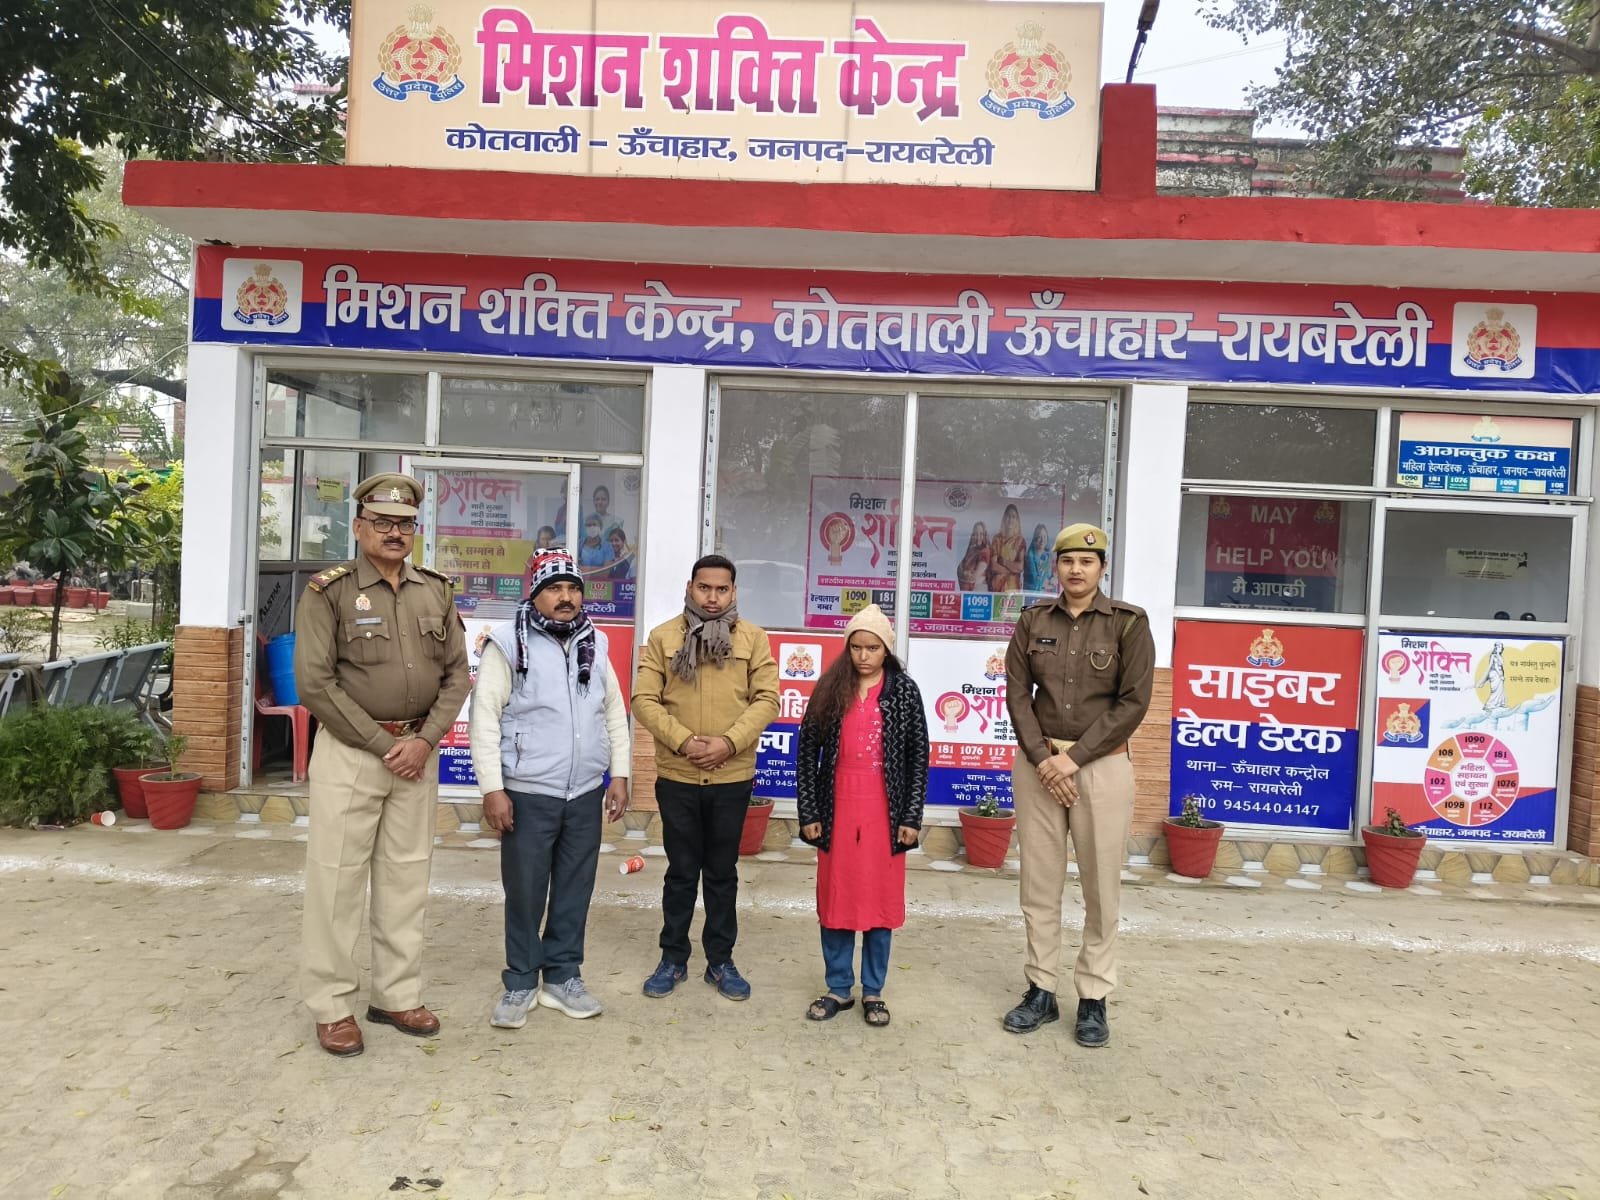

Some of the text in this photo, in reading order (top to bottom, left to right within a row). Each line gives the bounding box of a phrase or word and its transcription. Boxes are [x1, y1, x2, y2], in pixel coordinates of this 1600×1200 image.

[478, 8, 966, 122] मिशन शक्ति केन्द्र
[446, 123, 579, 154] कोतवाली
[618, 127, 737, 162] ऊँचाहार,
[322, 264, 467, 332] मिशन
[477, 272, 614, 340] शक्ति
[623, 280, 755, 353] केन्द्र,
[772, 286, 994, 356] कोतवाली
[1413, 444, 1557, 462] आगन्तुक कक्ष
[1402, 458, 1426, 472] महिला
[849, 492, 887, 510] मिशन
[1250, 504, 1298, 524] MAY
[1269, 527, 1275, 545] I
[1216, 546, 1327, 569] HELP YOU
[1250, 578, 1306, 598] आपकी
[846, 591, 867, 601] 1090
[911, 593, 928, 604] 076
[939, 594, 956, 605] 112
[968, 596, 989, 607] 1098
[1401, 637, 1428, 649] मिशन
[961, 683, 997, 696] मिशन
[1187, 663, 1342, 708] साइबर
[1176, 707, 1347, 754] हेल्प डेस्क
[1464, 735, 1486, 743] 1090
[938, 744, 954, 754] 181
[960, 746, 984, 756] 1076
[988, 746, 1006, 757] 112
[1438, 749, 1454, 757] 108
[1494, 751, 1507, 759] 181
[1231, 759, 1281, 776] ऊँचाहार
[1430, 777, 1446, 785] 102
[1497, 780, 1517, 788] 1076
[1247, 781, 1303, 797] रायबरेली
[1223, 799, 1320, 816] 9454404147
[1444, 801, 1465, 809] 1098
[1479, 802, 1494, 810] 112
